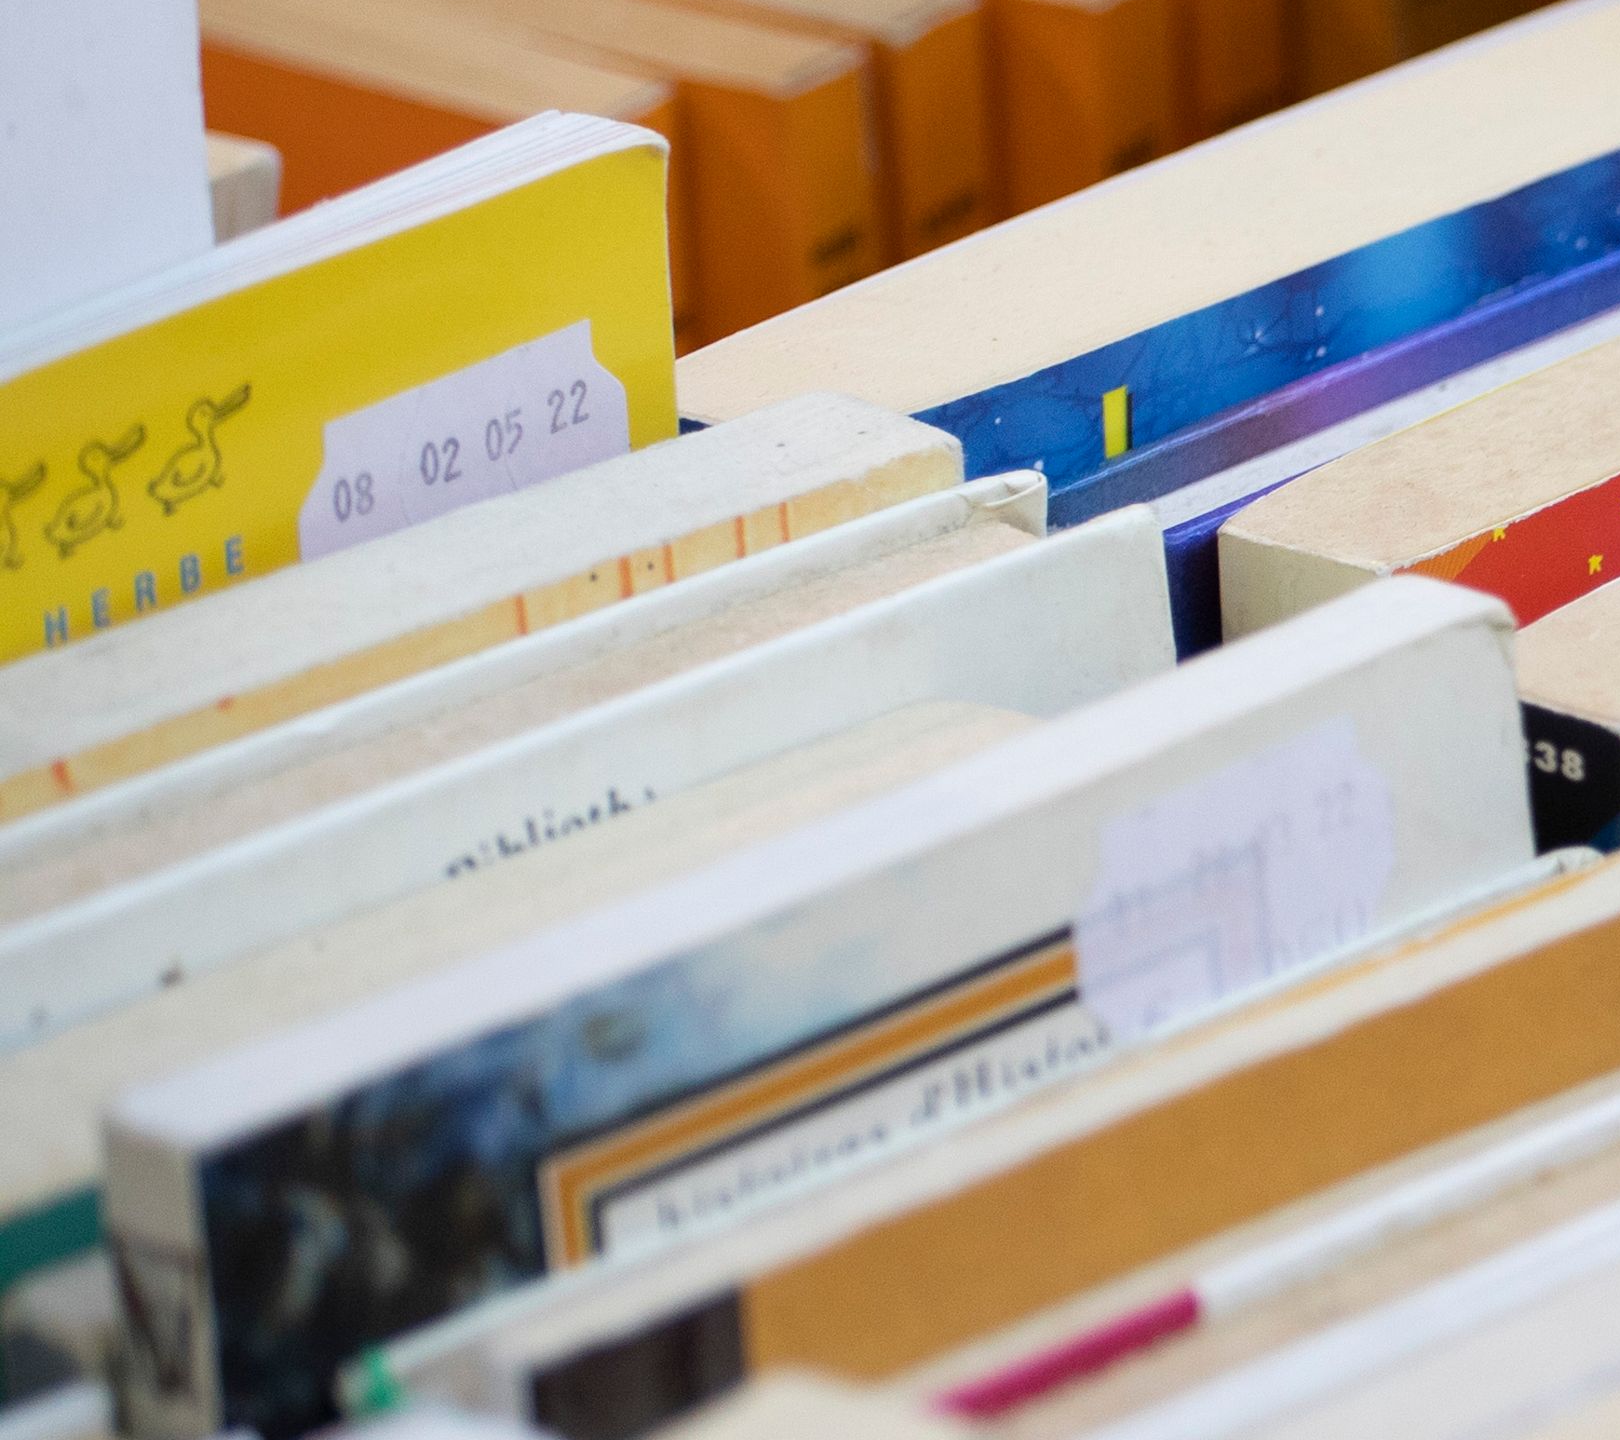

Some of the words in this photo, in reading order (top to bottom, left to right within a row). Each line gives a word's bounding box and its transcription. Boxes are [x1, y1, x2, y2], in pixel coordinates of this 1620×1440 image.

[333, 471, 374, 523] 08
[419, 436, 463, 486] 02
[485, 408, 524, 462] 05
[547, 378, 591, 435] 22
